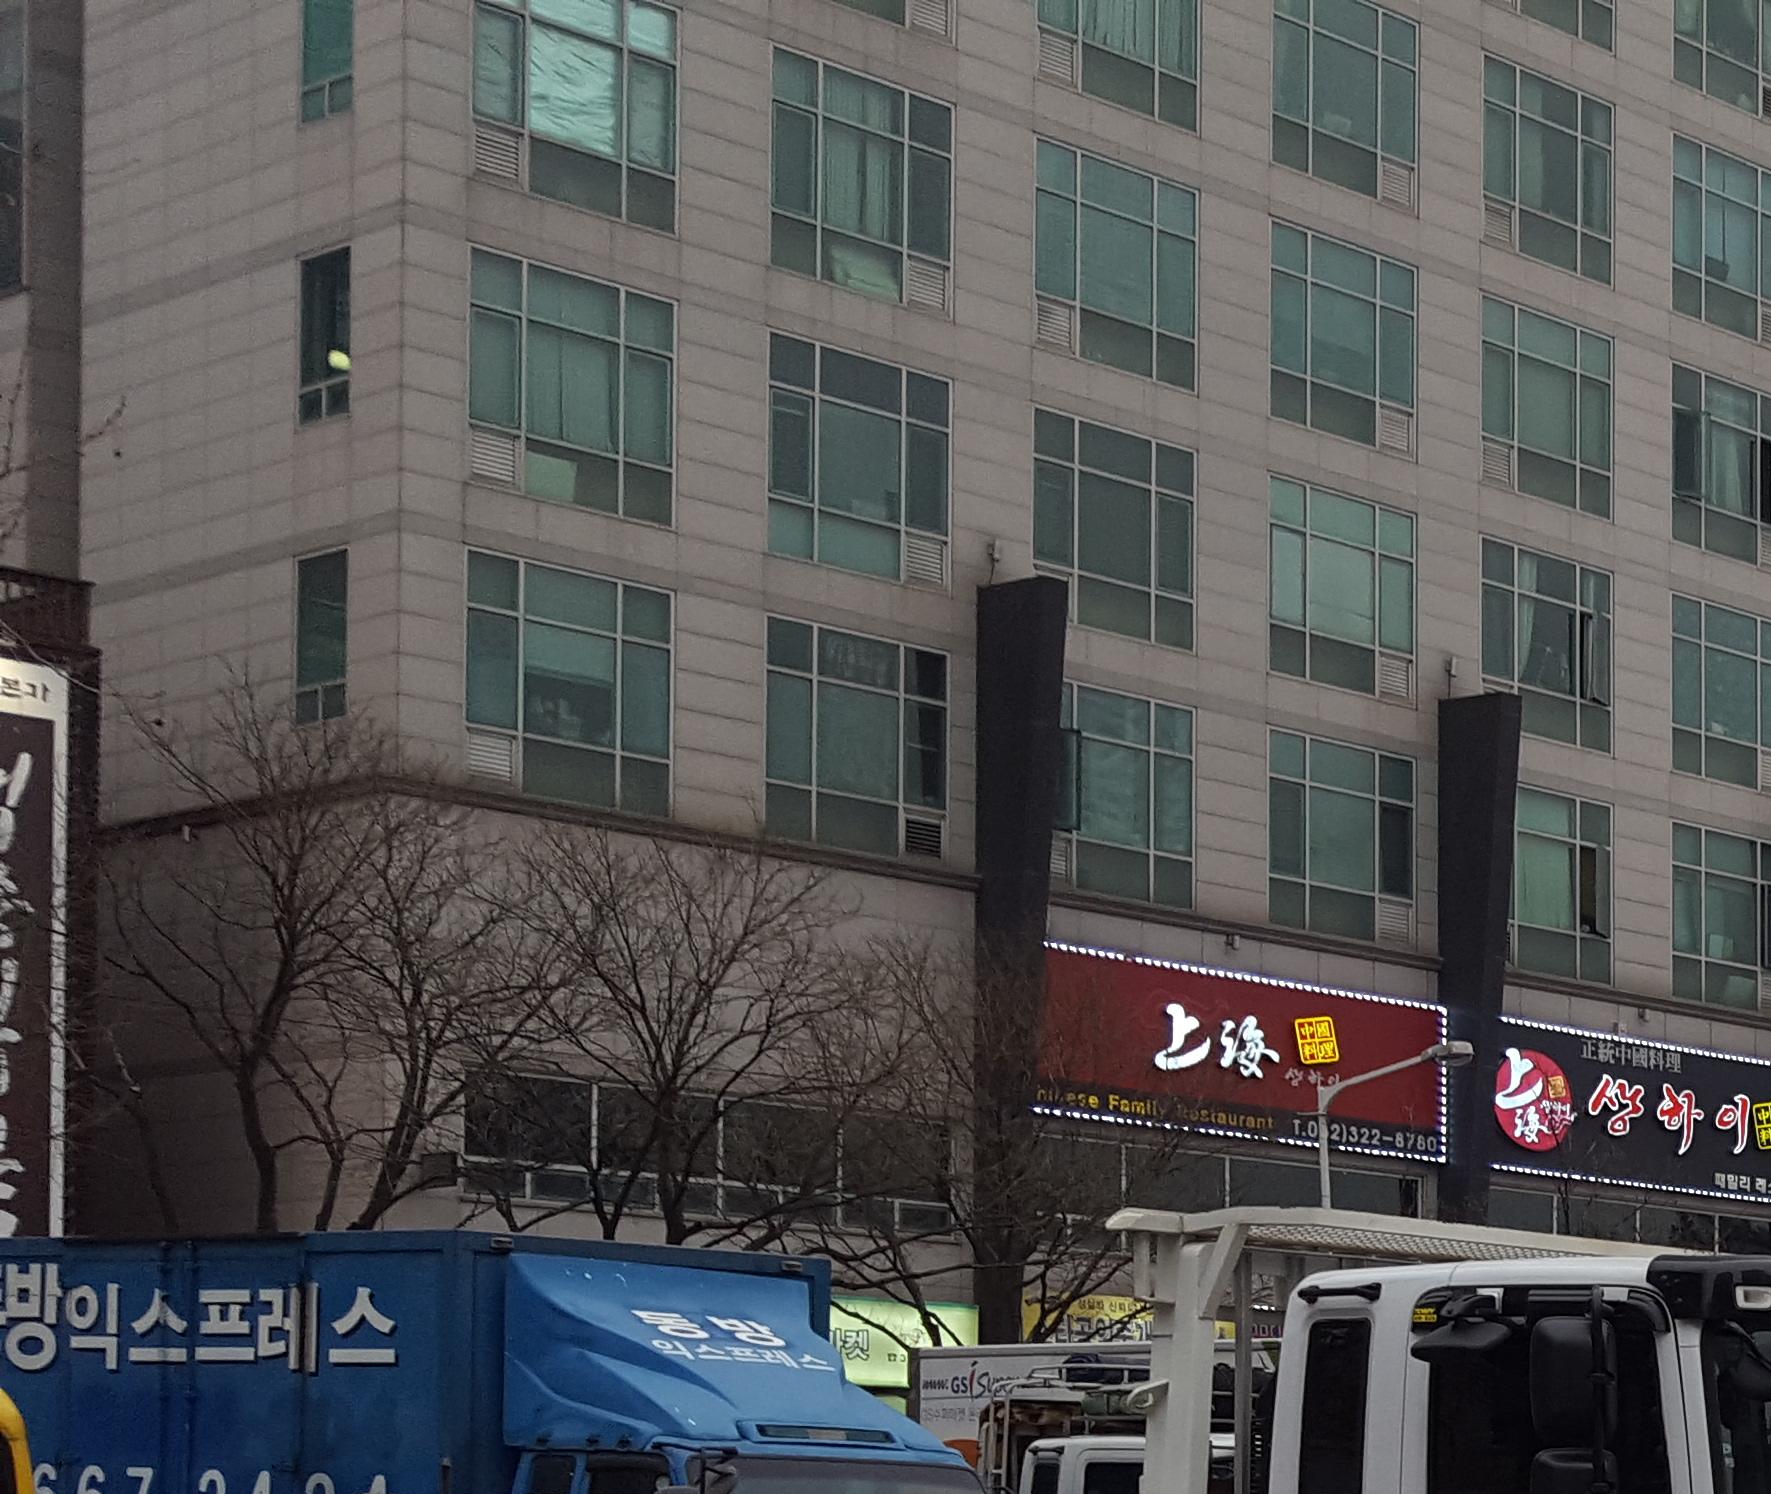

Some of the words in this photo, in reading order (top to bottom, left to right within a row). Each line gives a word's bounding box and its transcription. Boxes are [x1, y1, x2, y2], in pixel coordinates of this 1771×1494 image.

[1153, 1003, 1281, 1079] 上海
[1580, 1039, 1683, 1074] 正統中國料理
[1589, 1073, 1750, 1155] 상하이
[0, 1262, 397, 1373] 방익스프레스
[631, 1309, 787, 1348] 동방
[651, 1339, 836, 1372] 익스프레스
